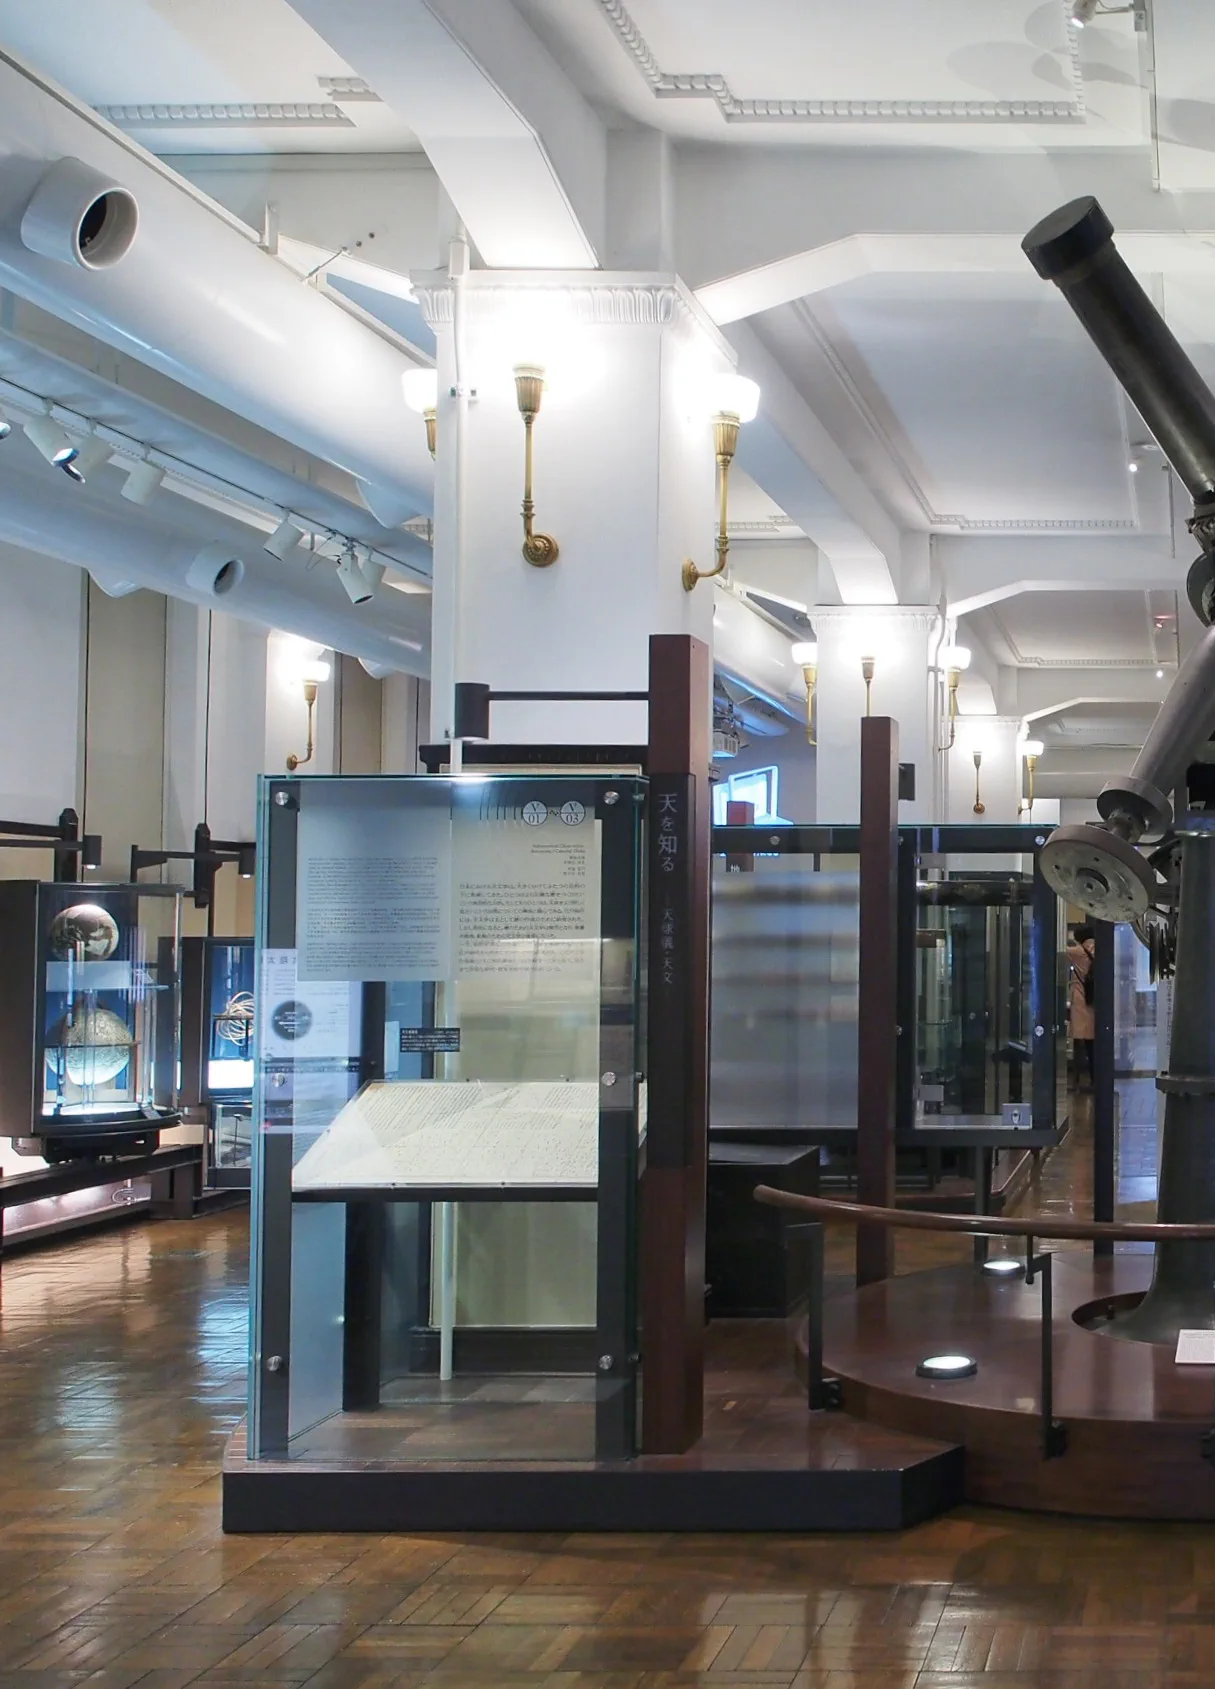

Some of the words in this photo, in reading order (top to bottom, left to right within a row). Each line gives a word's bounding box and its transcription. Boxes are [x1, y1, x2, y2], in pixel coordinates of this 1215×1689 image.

[528, 814, 541, 824] 01
[566, 813, 580, 824] 03
[658, 793, 679, 872] 天を知る
